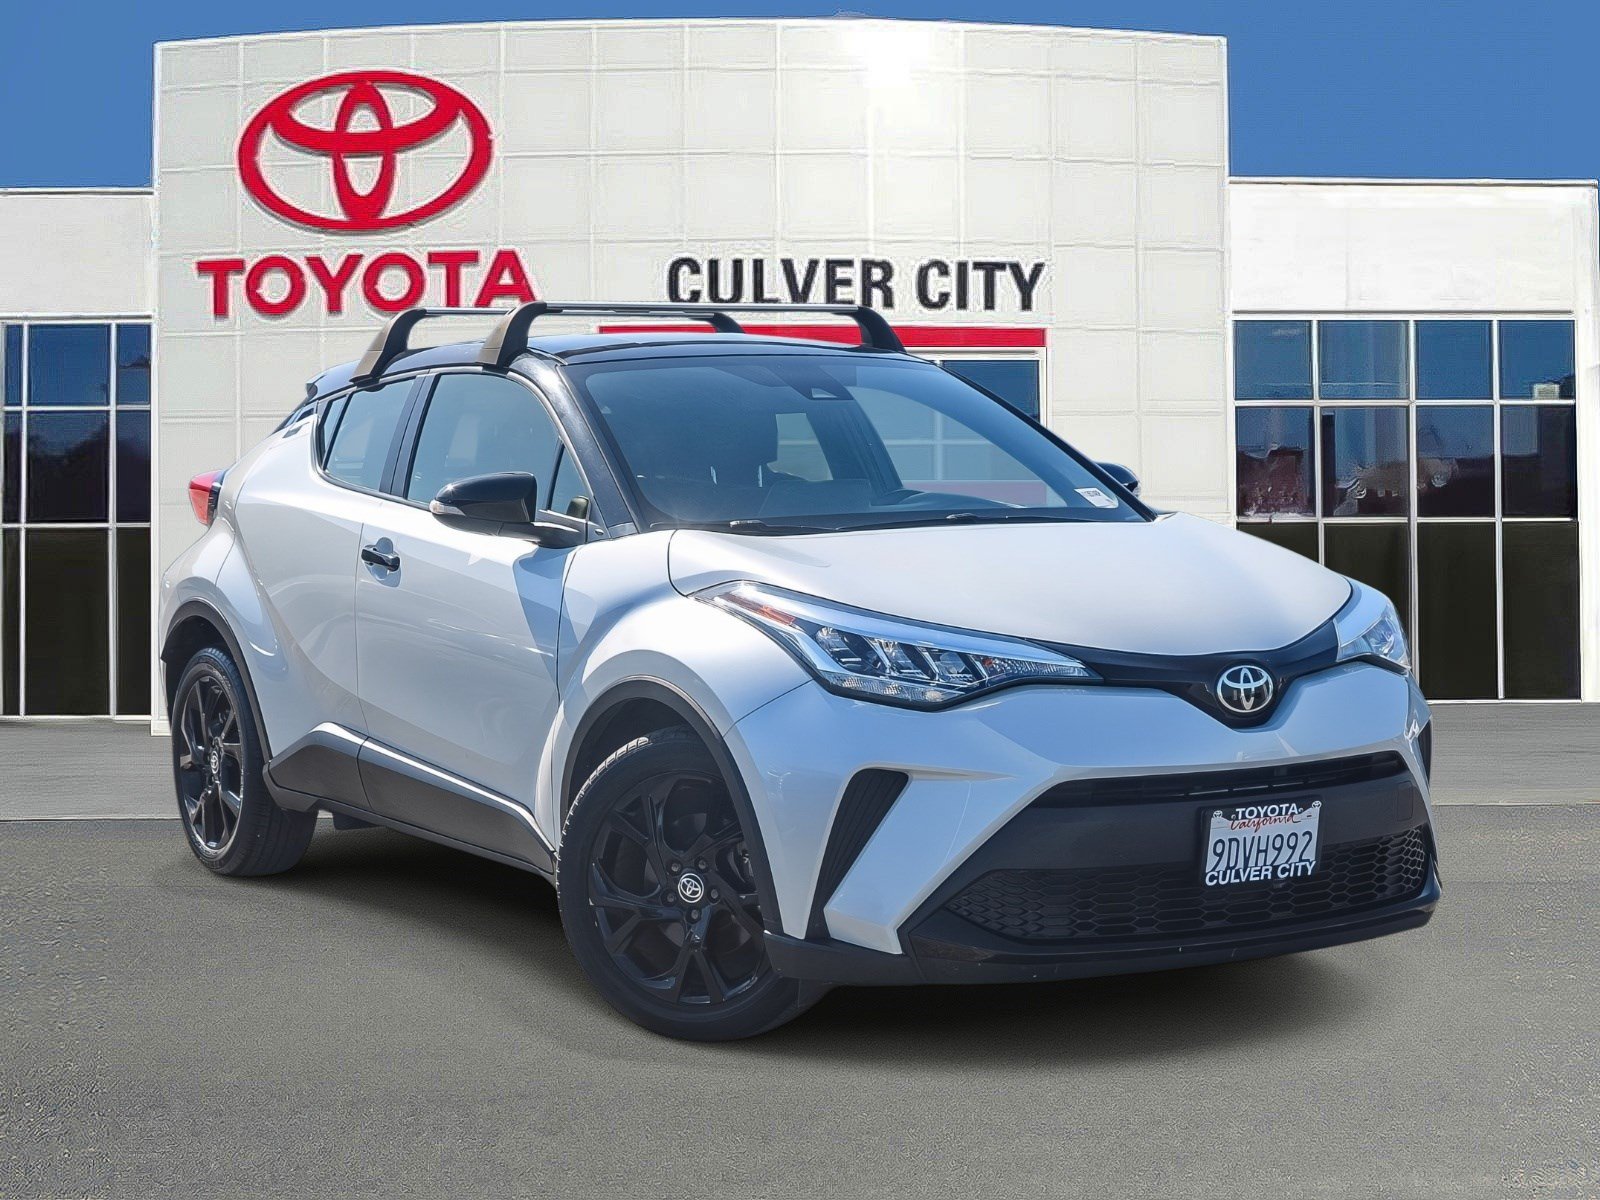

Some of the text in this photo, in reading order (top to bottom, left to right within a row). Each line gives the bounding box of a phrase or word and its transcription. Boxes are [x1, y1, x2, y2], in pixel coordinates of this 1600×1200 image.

[195, 249, 537, 318] TOYOTA
[667, 257, 1046, 311] CULVER CITY
[1235, 803, 1299, 820] TOYOTA
[1212, 830, 1313, 872] 9DVH992
[1205, 860, 1317, 887] CULVER CITY
